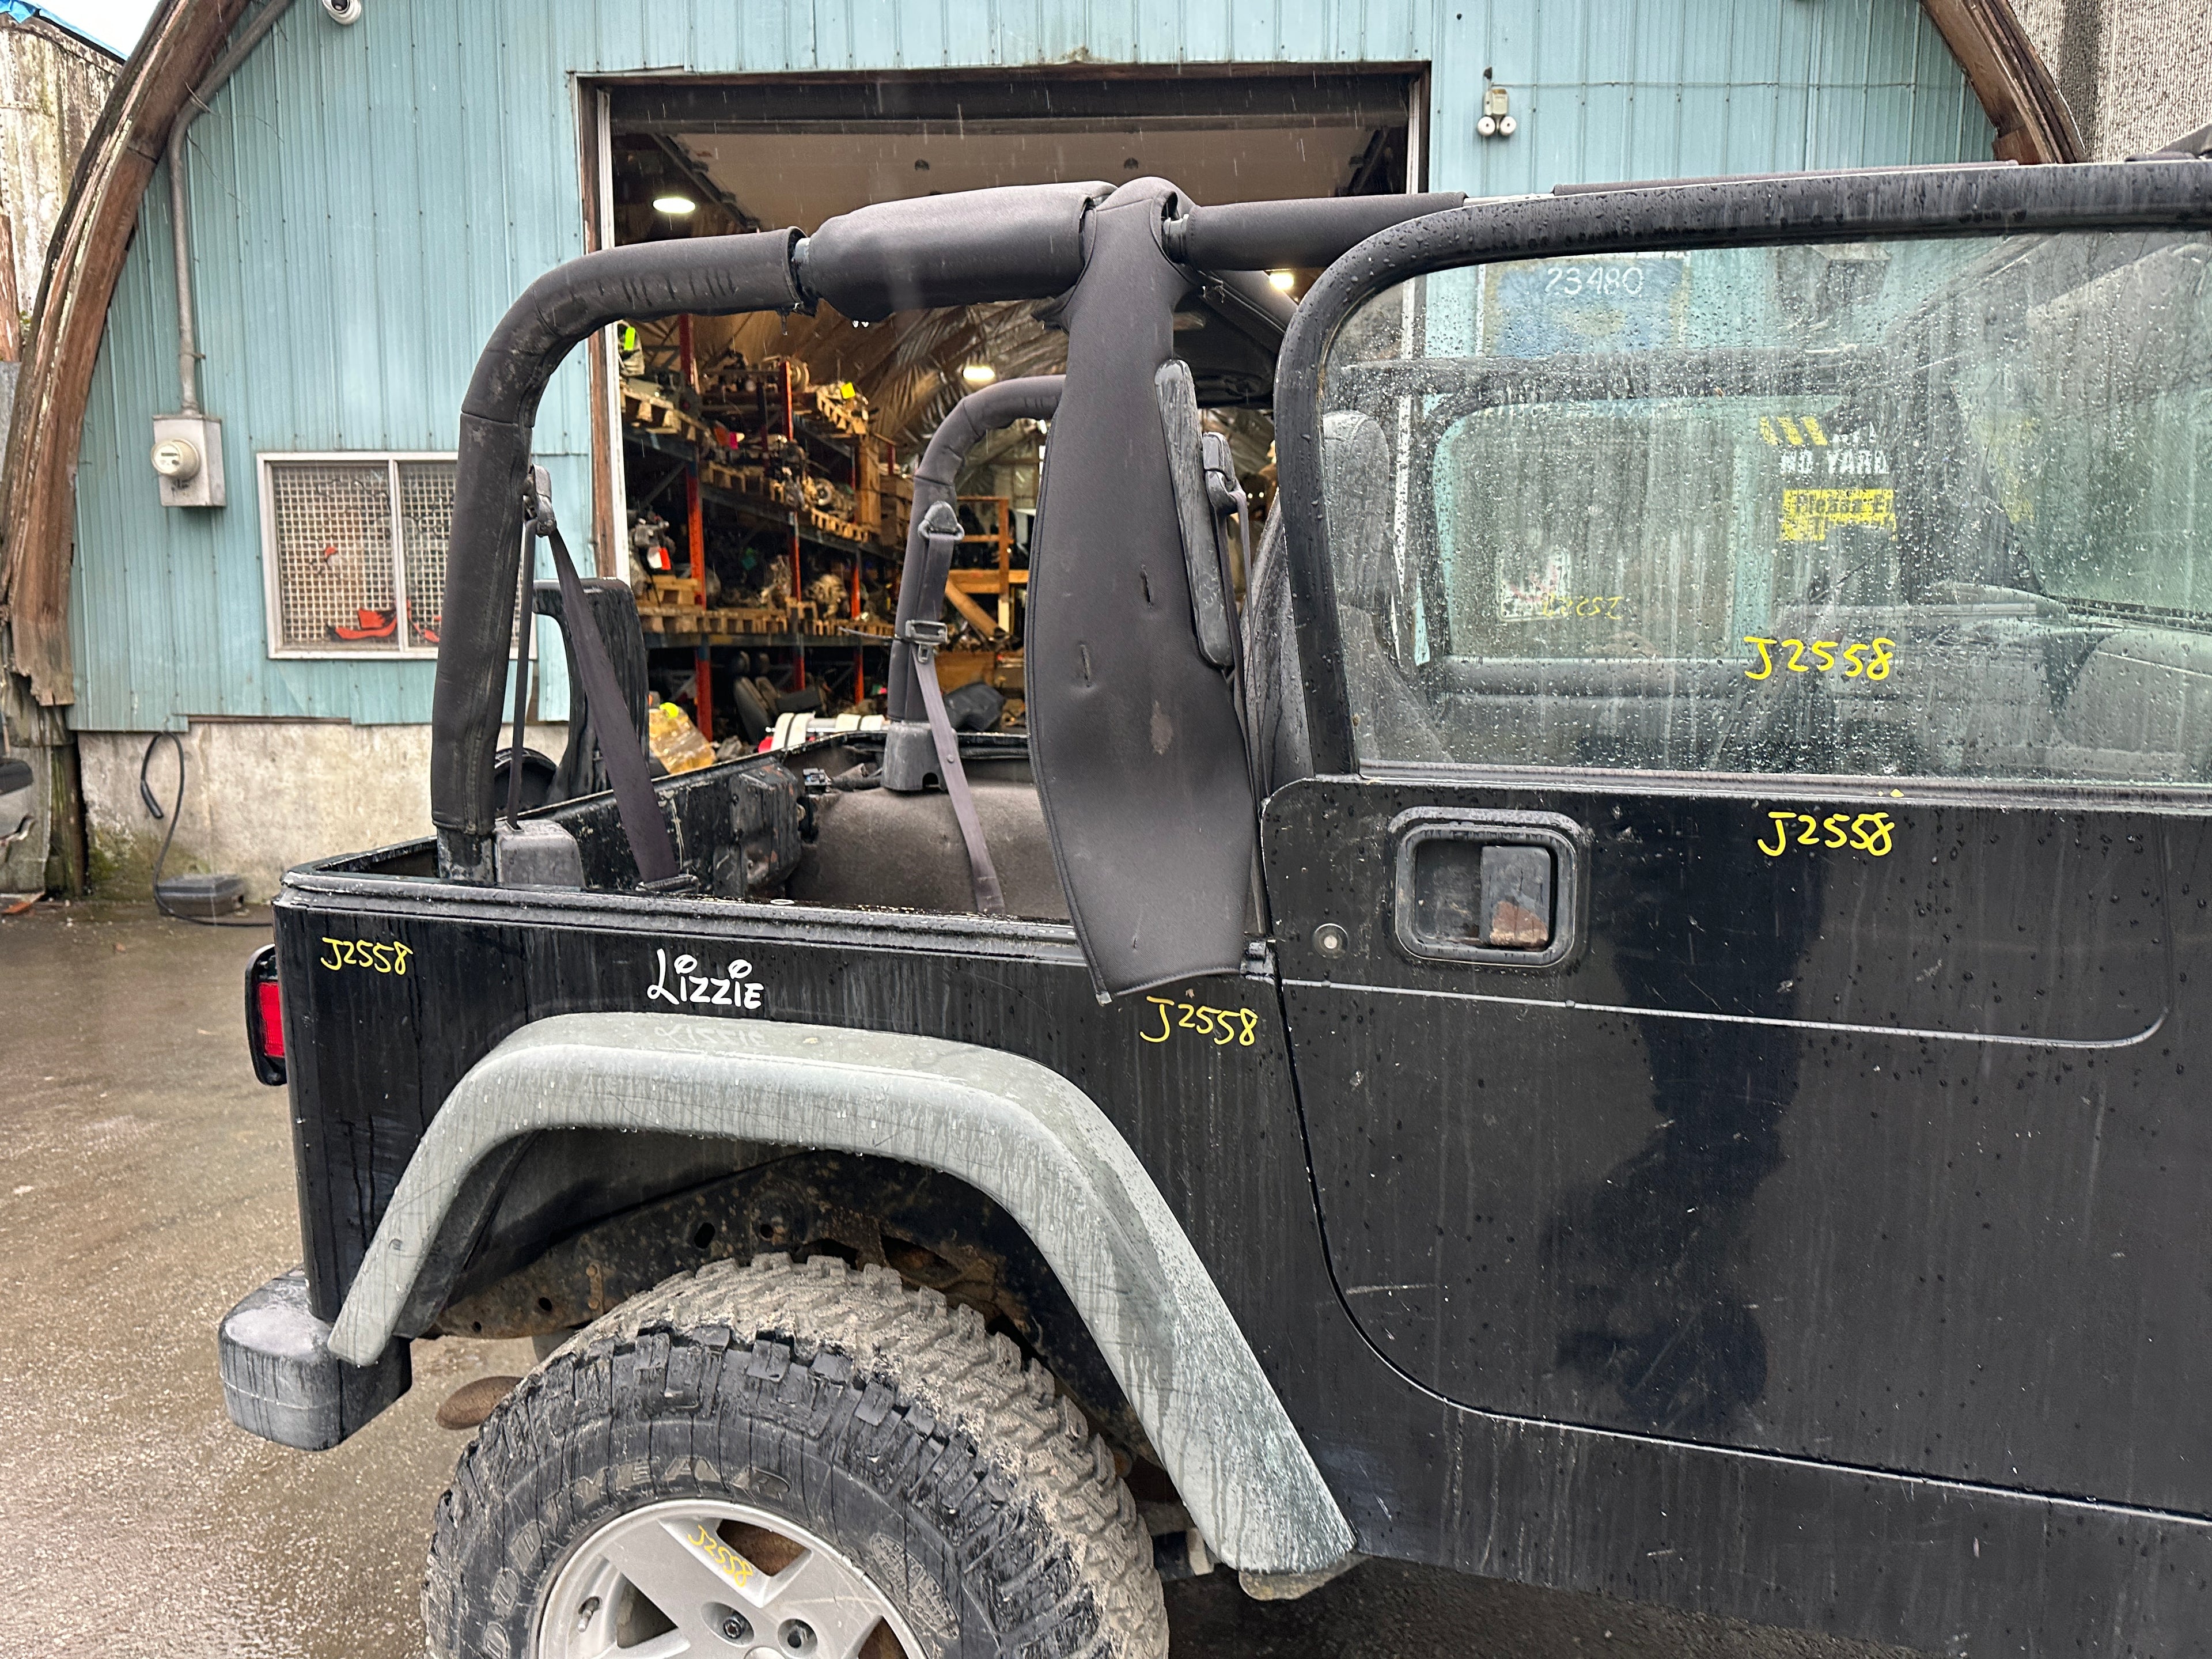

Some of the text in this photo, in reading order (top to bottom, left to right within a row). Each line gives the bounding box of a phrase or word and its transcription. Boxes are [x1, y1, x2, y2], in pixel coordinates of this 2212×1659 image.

[1780, 450, 1813, 475] NO
[1744, 637, 1895, 680] J2558
[1758, 812, 1895, 857] J2558
[320, 937, 413, 975] J2558
[1139, 995, 1259, 1046] J2558
[687, 1525, 753, 1588] J2558
